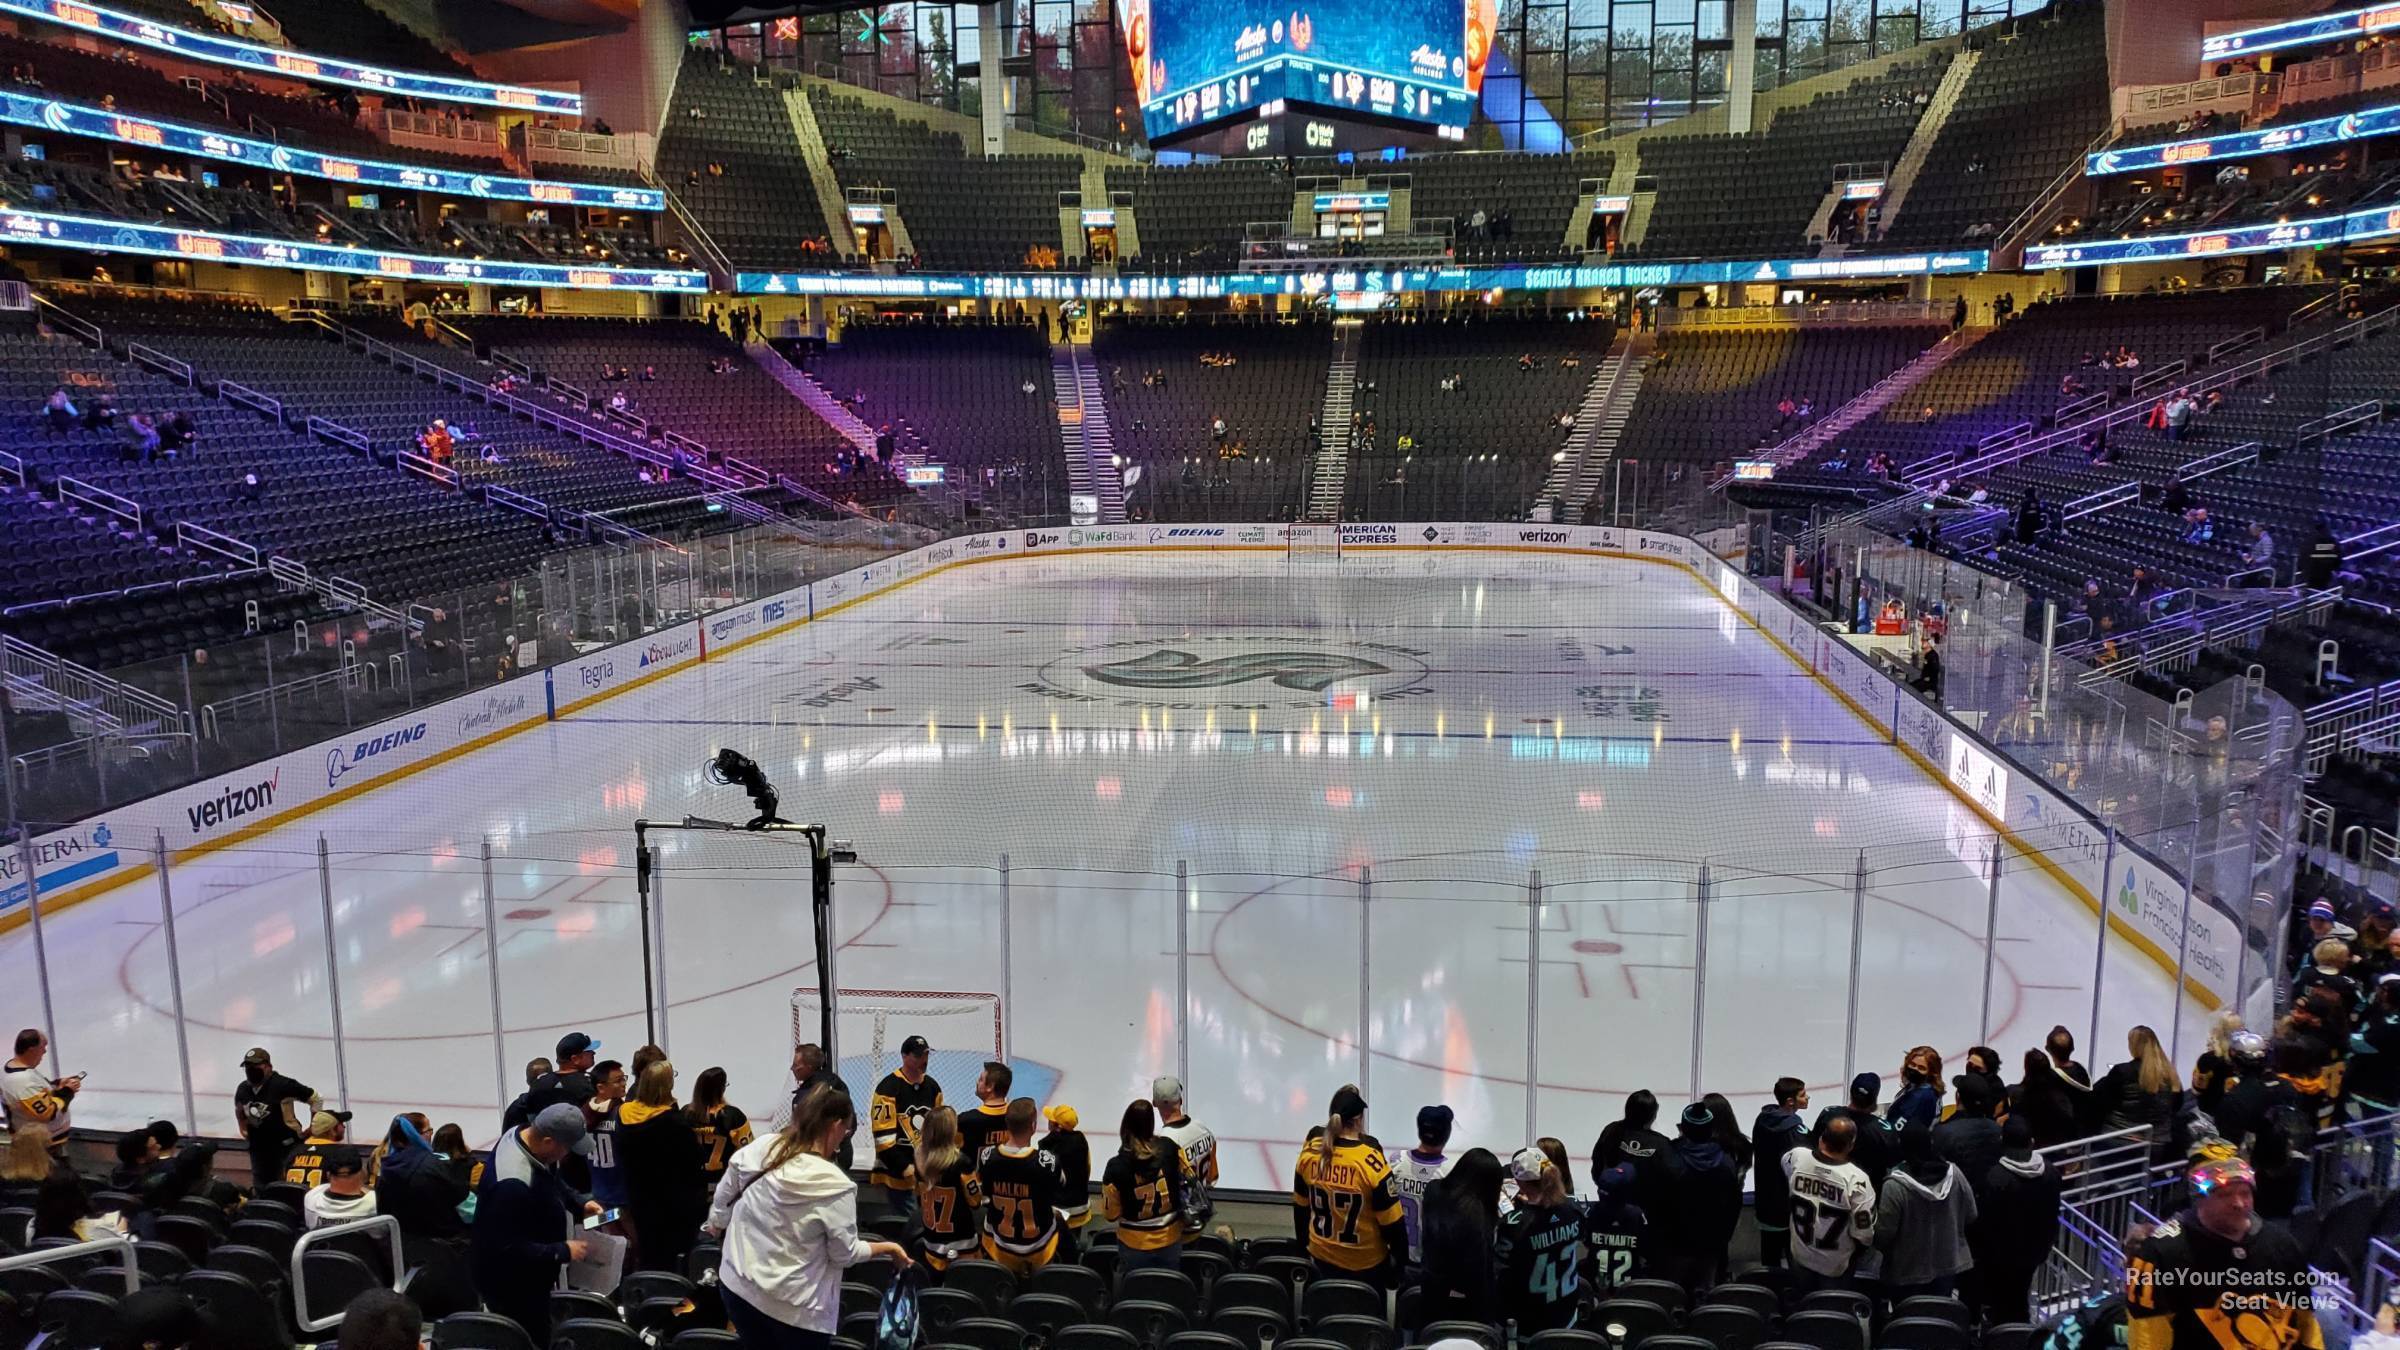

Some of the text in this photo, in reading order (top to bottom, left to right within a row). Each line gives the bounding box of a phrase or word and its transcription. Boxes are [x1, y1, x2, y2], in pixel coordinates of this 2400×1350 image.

[1235, 23, 1266, 52] Alaska
[1411, 44, 1447, 69] Alaska
[1625, 264, 1671, 285] HOCKEY
[1085, 528, 1136, 542] WaFd Bank
[1168, 528, 1224, 537] BOEING
[1277, 529, 1312, 537] amazon
[1334, 525, 1396, 534] AMERICAN
[1342, 535, 1397, 544] EXPRESS
[1519, 529, 1567, 544] verizon
[965, 536, 991, 550] Alaska
[712, 610, 756, 637] amazon music
[762, 600, 785, 625] MPS
[672, 638, 693, 657] LIGHT
[579, 660, 614, 689] Tegria
[353, 723, 426, 763] BOEING
[188, 779, 273, 834] verizon
[874, 1103, 892, 1121] 71
[1184, 1134, 1213, 1162] EMIEUX
[993, 1180, 1030, 1198] MALKIN
[1402, 1178, 1428, 1195] CROS
[1794, 1174, 1845, 1203] CROSBY
[992, 1195, 1041, 1239] 71
[1309, 1184, 1364, 1244] 87
[1790, 1194, 1850, 1250] 87
[1530, 1220, 1580, 1251] WILLIAMS
[1591, 1232, 1638, 1249] REYNANTE
[1528, 1240, 1580, 1304] 42
[1596, 1249, 1632, 1288] 12
